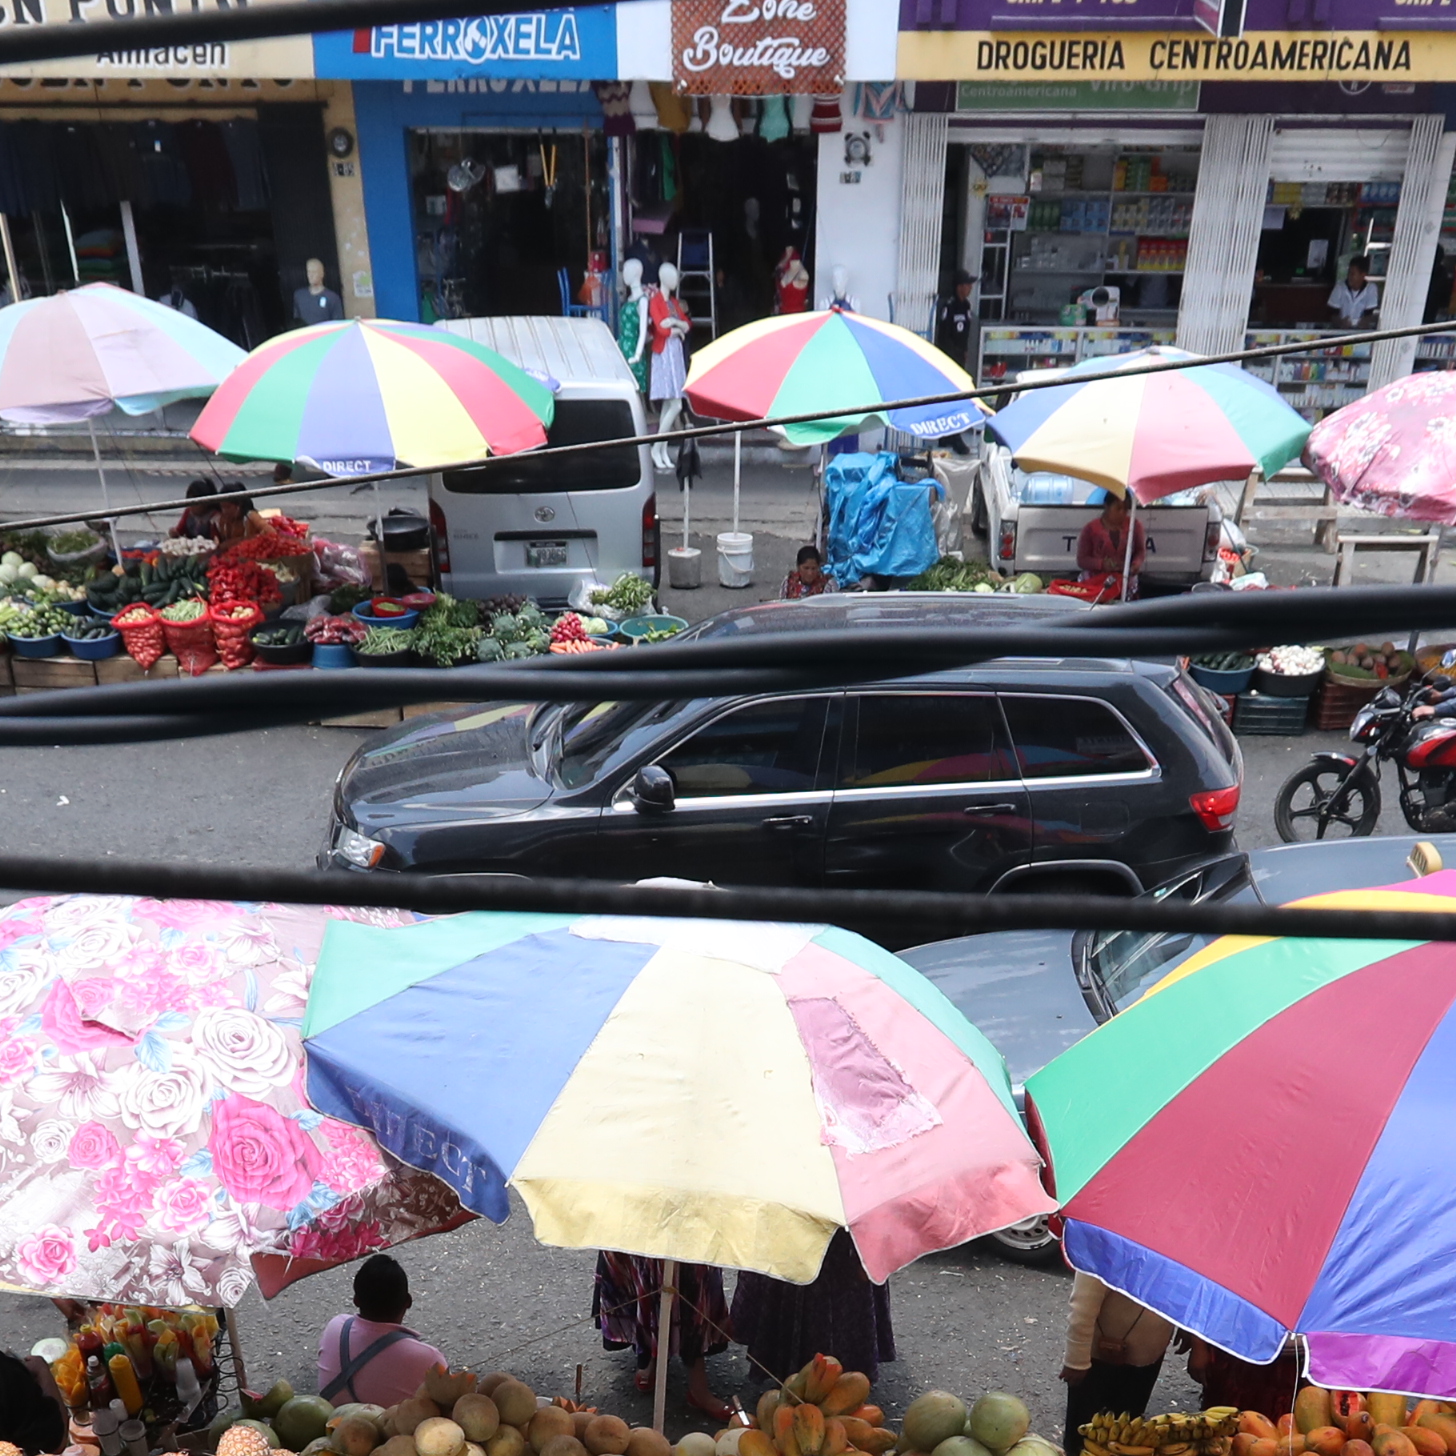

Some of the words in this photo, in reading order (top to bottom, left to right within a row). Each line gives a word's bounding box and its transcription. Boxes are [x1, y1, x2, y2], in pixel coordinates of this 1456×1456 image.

[684, 26, 831, 79] Boutique
[976, 40, 1126, 71] DROGUERIA
[1149, 39, 1412, 71] CENTROAMERICANA
[909, 412, 971, 435] DIRECT
[322, 460, 371, 472] DIRECT
